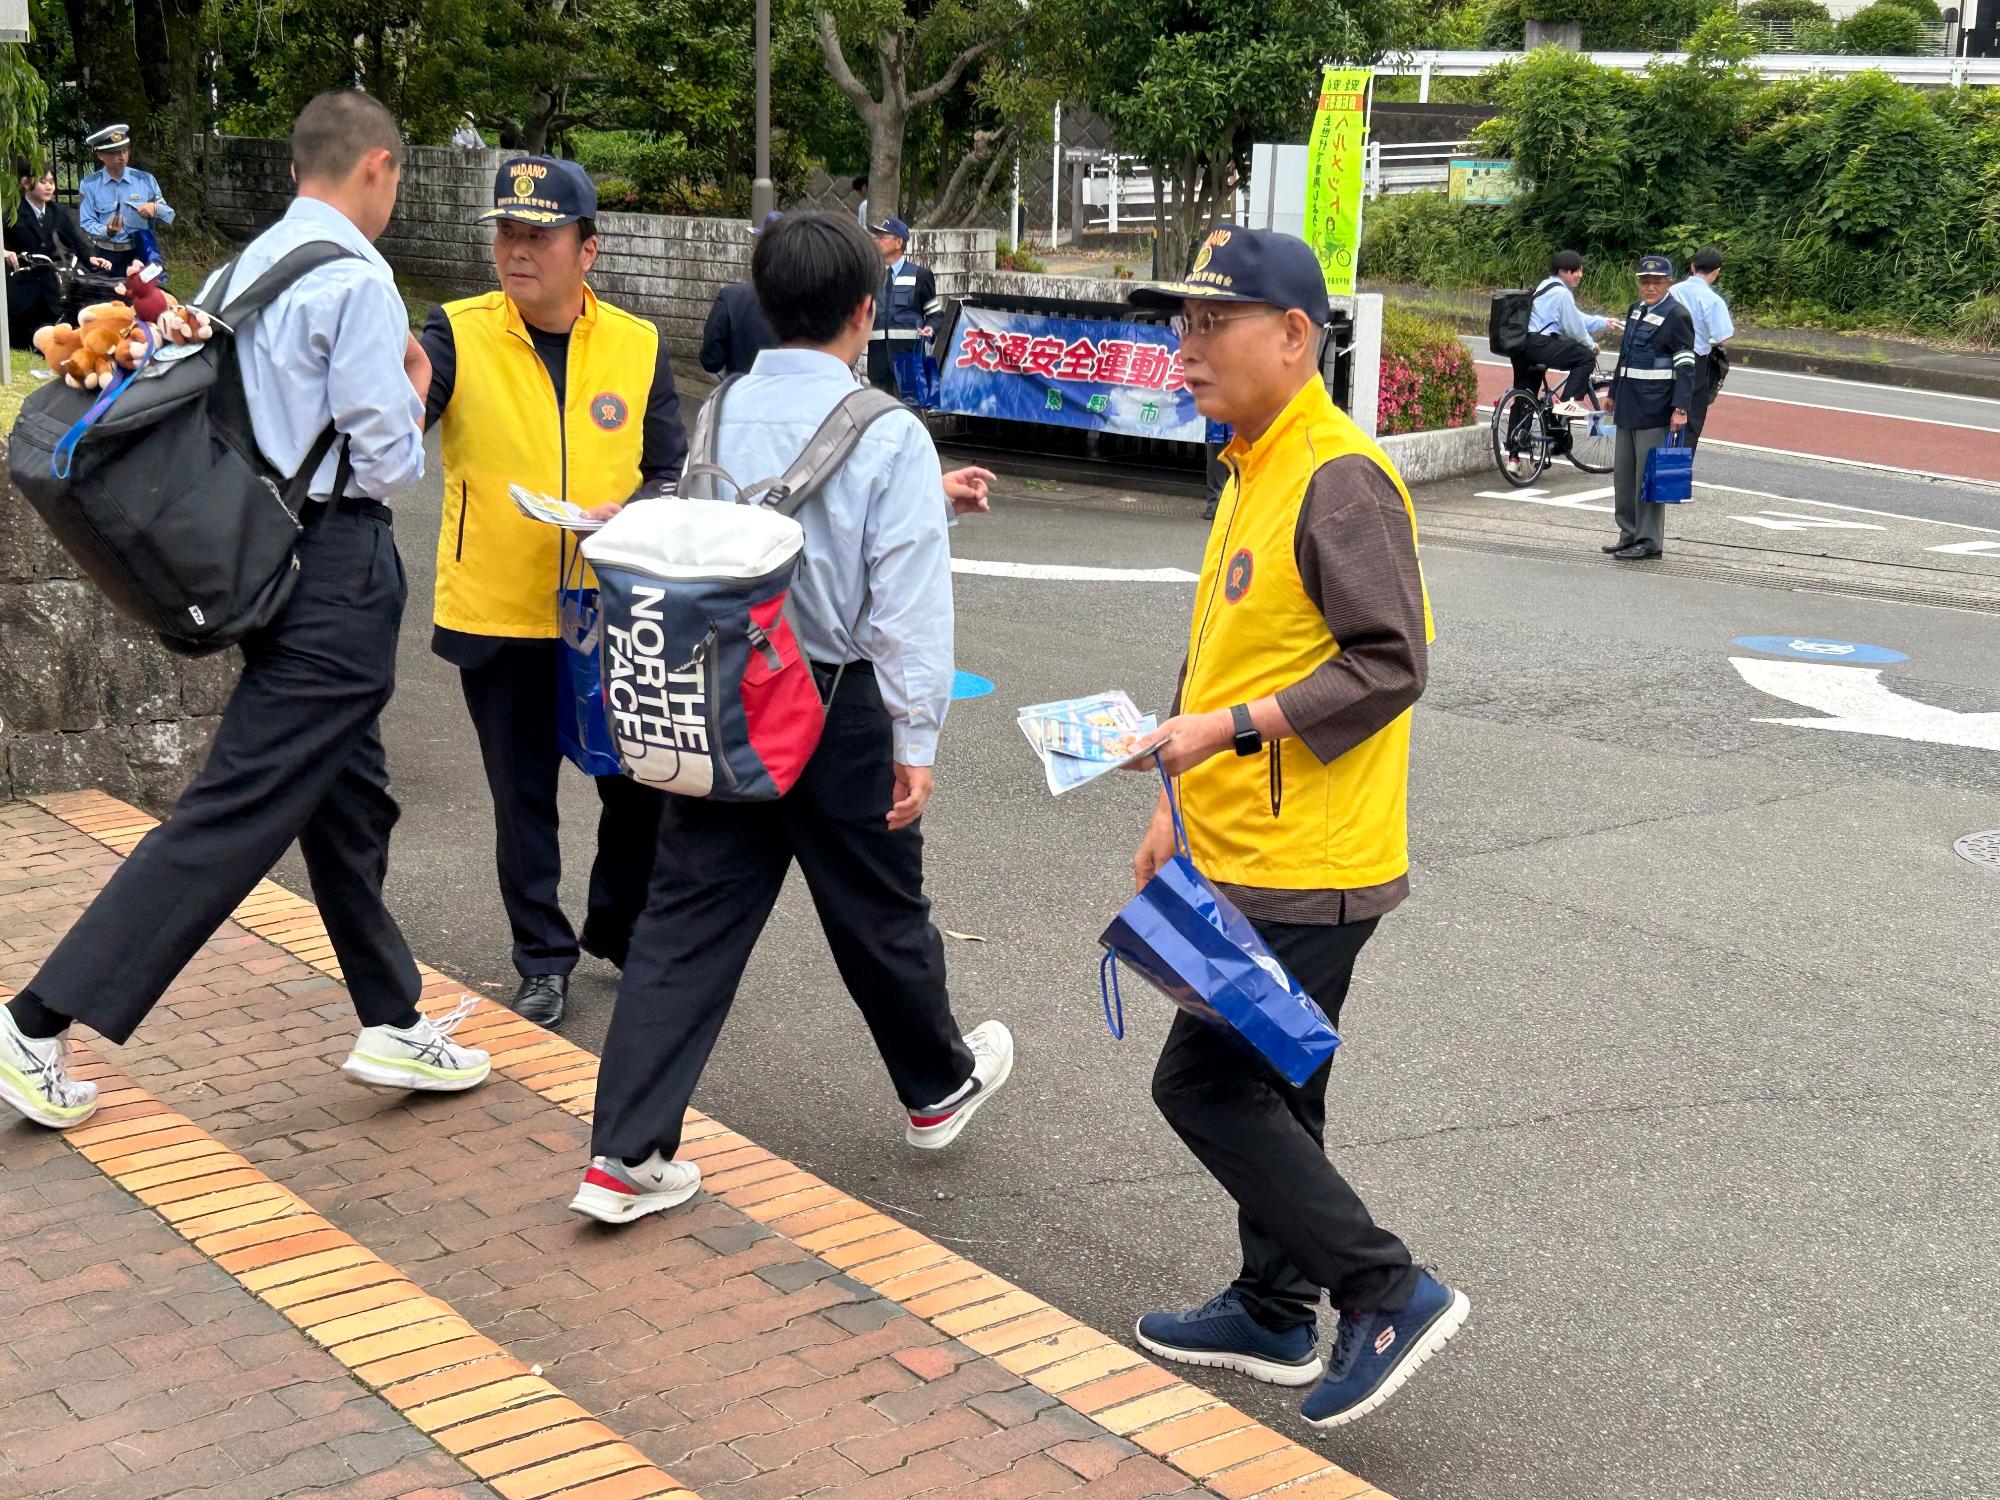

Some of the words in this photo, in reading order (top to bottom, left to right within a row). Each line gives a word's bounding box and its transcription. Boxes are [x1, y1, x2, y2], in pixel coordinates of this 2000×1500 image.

[607, 624, 645, 741] FACE
[630, 585, 676, 748] NORTH
[667, 663, 710, 753] THE
